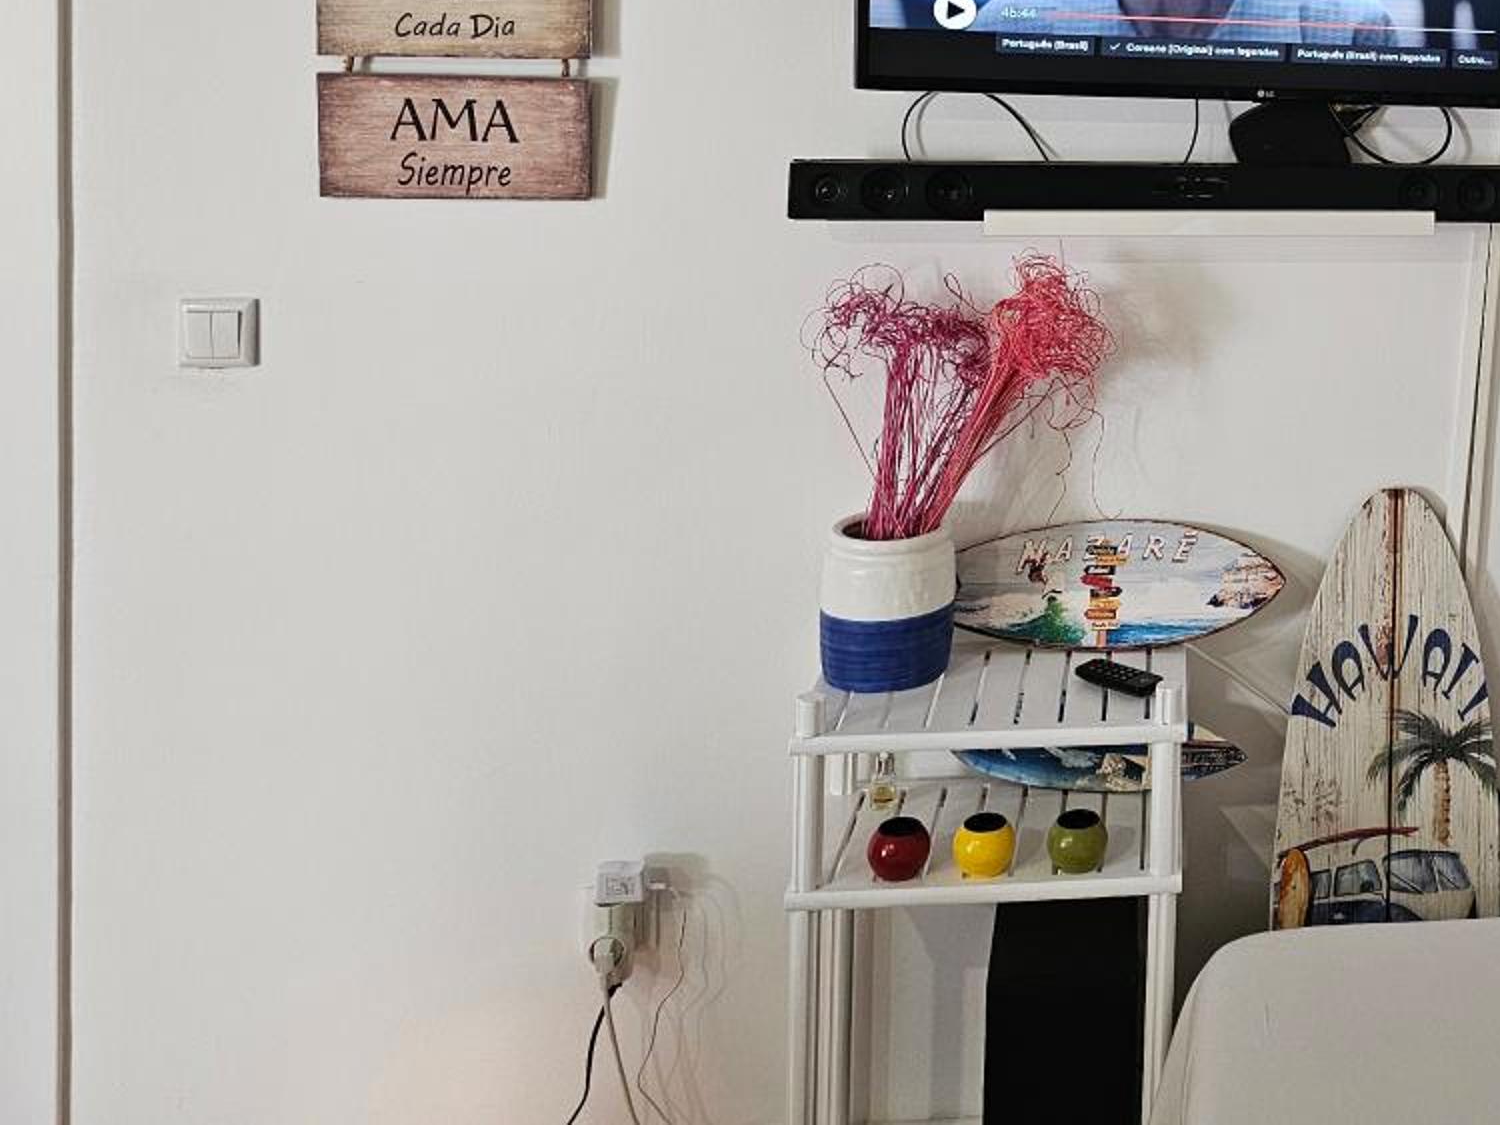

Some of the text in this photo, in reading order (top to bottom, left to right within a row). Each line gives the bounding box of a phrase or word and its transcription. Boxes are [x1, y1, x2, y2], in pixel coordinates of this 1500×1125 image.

[394, 13, 461, 38] Cada
[1001, 38, 1089, 52] Português (Brasil)
[1297, 49, 1344, 62] Português
[1346, 50, 1378, 63] (Brasil)
[390, 97, 520, 144] AMA
[398, 151, 512, 195] Siempre
[1290, 613, 1489, 729] HAWAII
